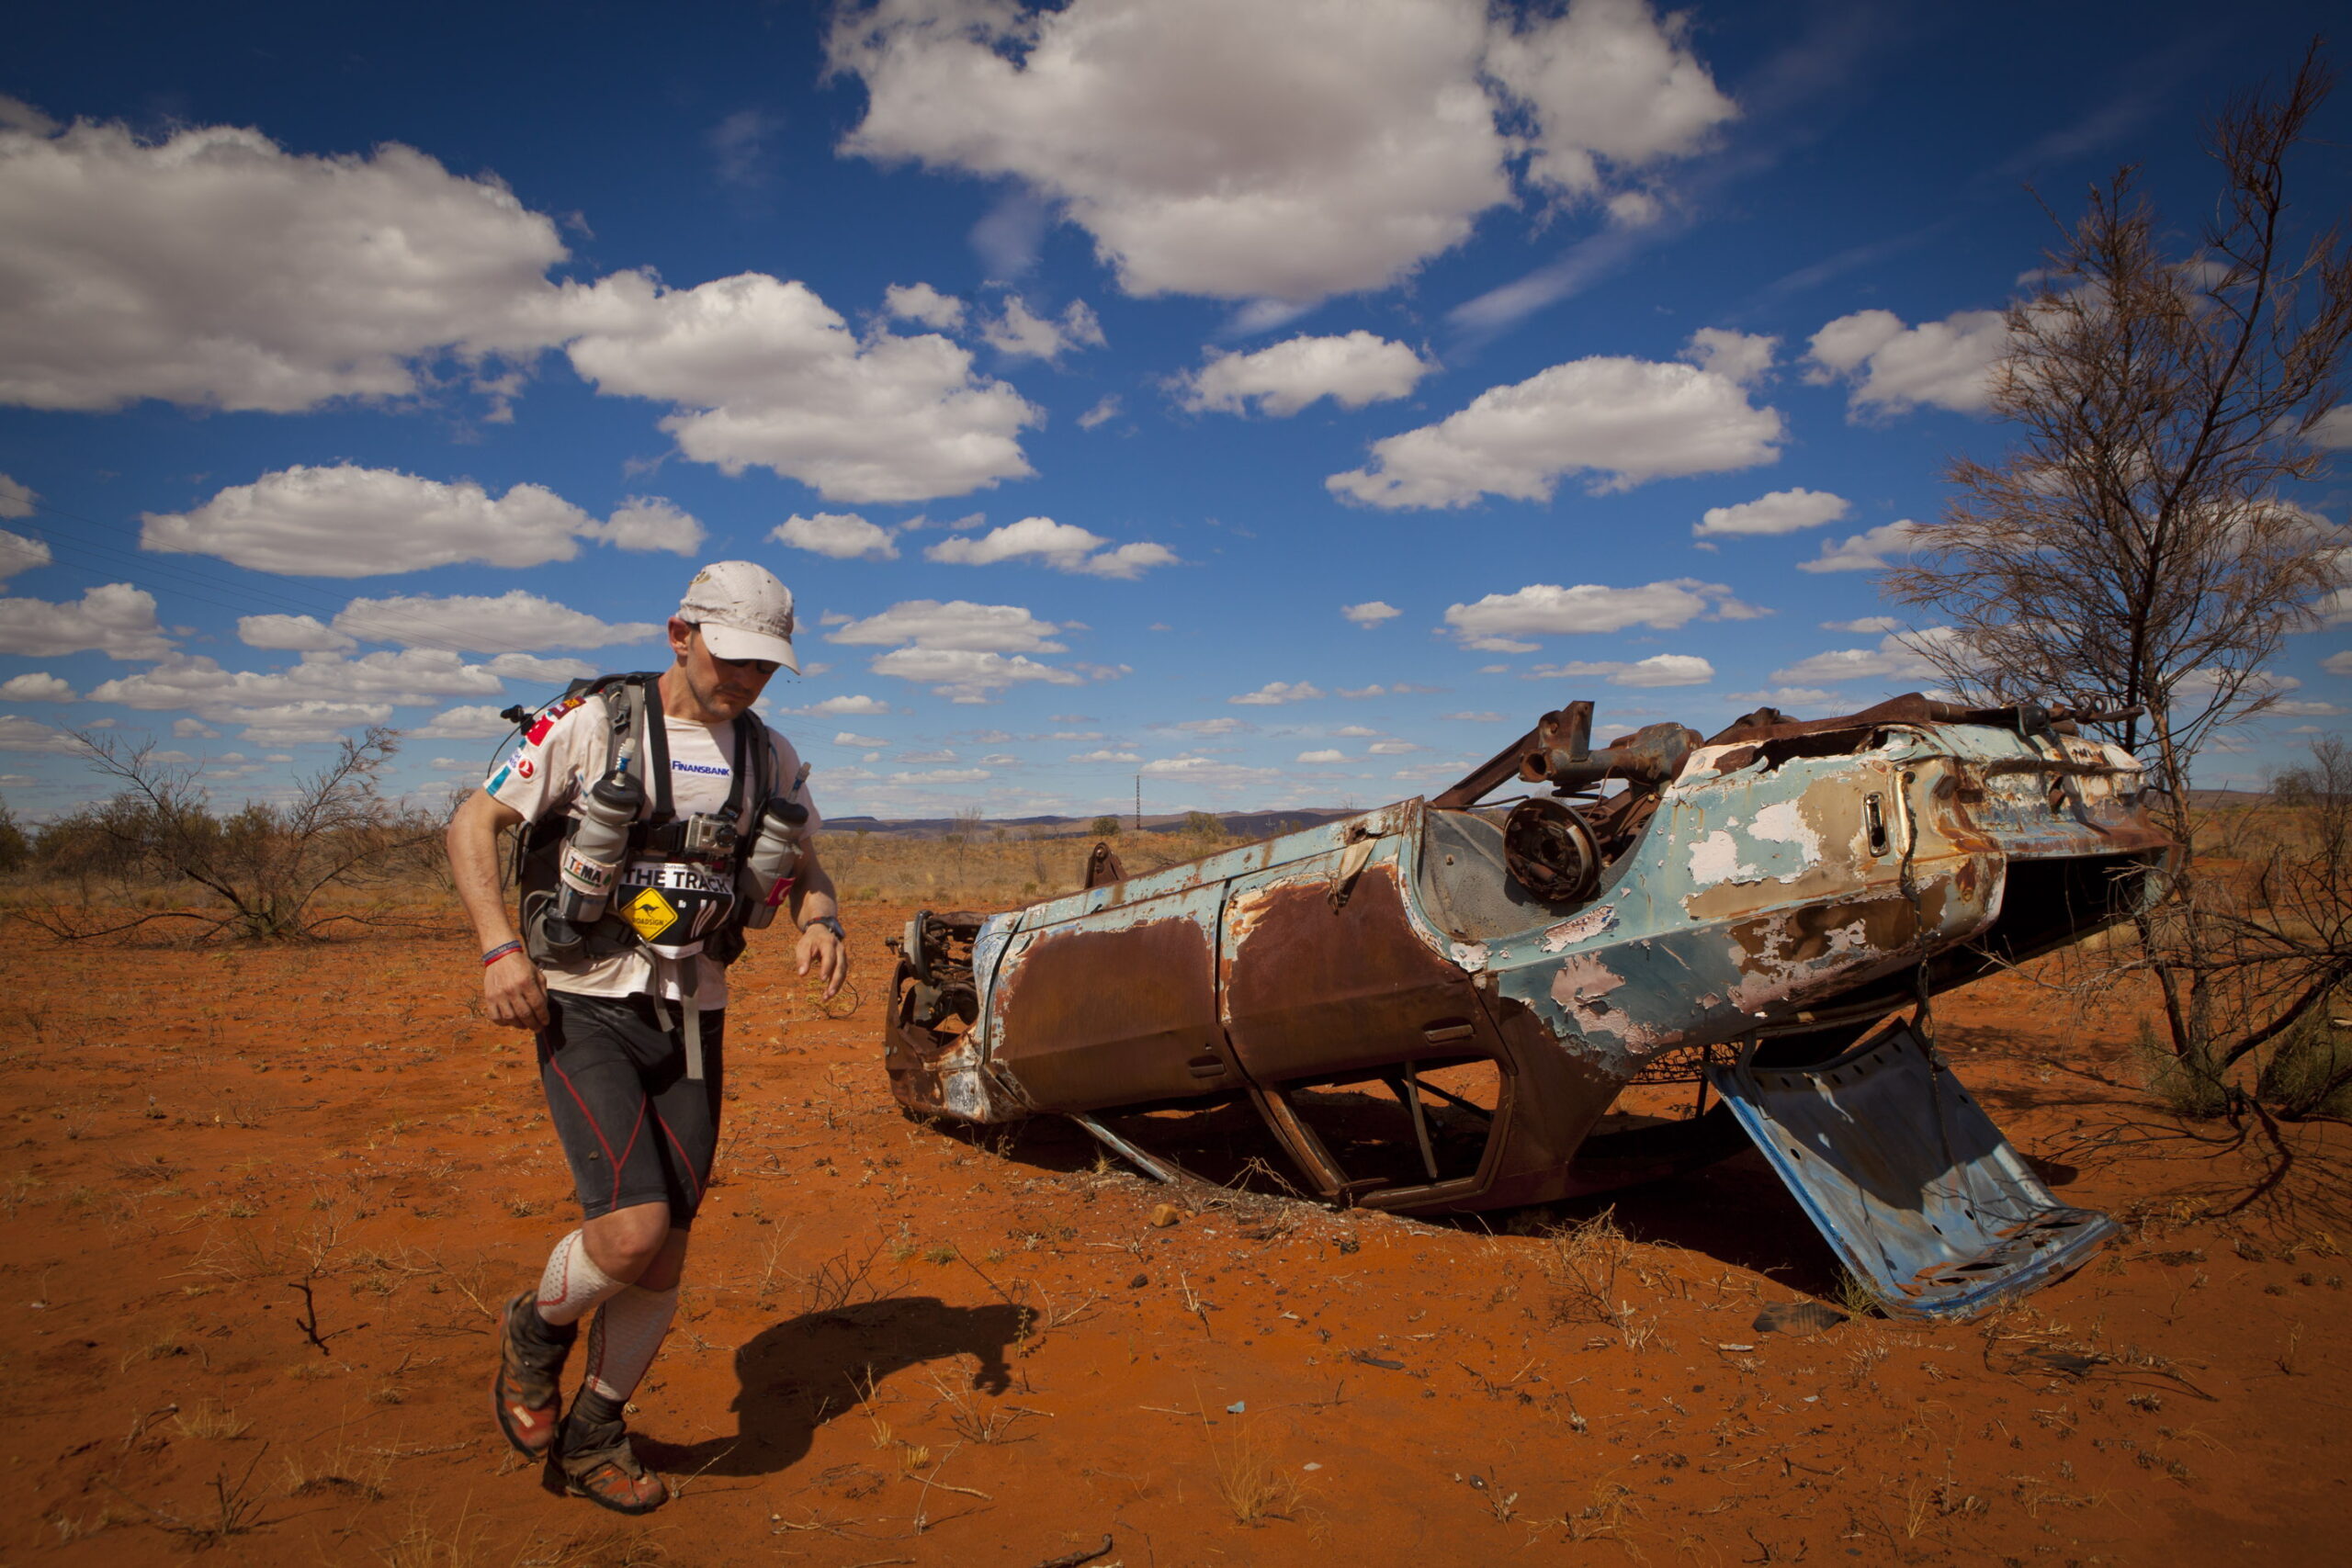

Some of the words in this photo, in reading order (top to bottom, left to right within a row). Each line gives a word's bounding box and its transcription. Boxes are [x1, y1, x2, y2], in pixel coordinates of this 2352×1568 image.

[672, 760, 729, 776] FINANSBANK
[570, 855, 603, 883] TEMA
[624, 868, 666, 887] THE
[673, 871, 730, 893] TRACK
